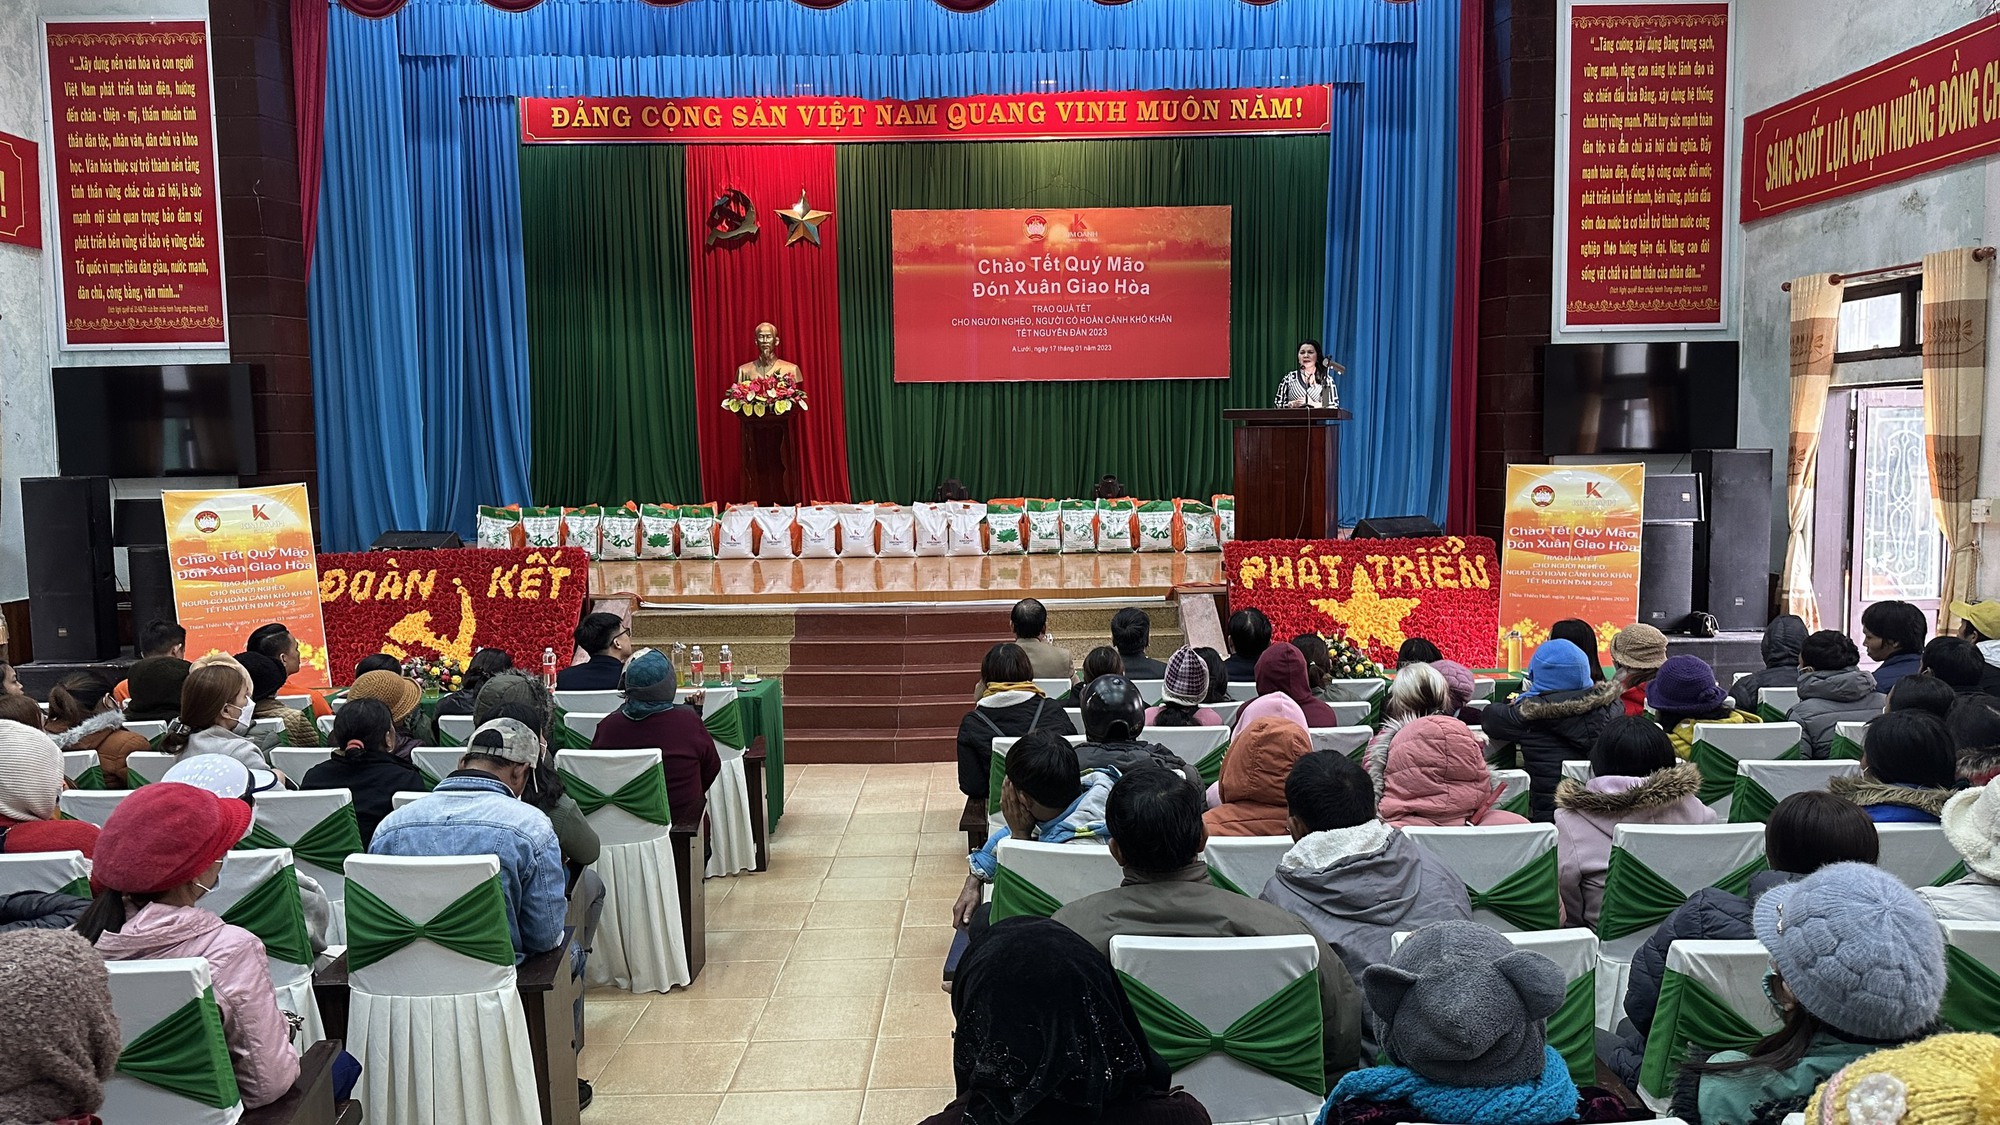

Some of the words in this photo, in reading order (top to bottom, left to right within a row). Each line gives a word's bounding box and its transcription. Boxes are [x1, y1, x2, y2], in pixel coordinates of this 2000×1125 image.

[1616, 36, 1633, 53] cường
[1635, 37, 1646, 53] xây
[1647, 36, 1662, 53] dựng
[1663, 33, 1679, 53] Đảng
[1681, 37, 1697, 52] trong
[1699, 35, 1715, 53] sạch,
[94, 56, 109, 73] dựng
[111, 54, 123, 70] nền
[125, 58, 137, 70] văn
[138, 56, 150, 70] hóa
[152, 57, 161, 70] và
[162, 59, 174, 70] con
[175, 55, 194, 72] người
[1584, 63, 1598, 80] vững
[1600, 62, 1619, 81] mạnh,
[1621, 63, 1635, 79] nâng
[1637, 65, 1648, 77] cao
[1651, 63, 1666, 78] năng
[1667, 61, 1677, 79] lực
[1678, 61, 1691, 76] lãnh
[1694, 61, 1705, 79] đạo
[1706, 63, 1714, 75] và
[64, 82, 78, 100] Việt
[82, 82, 96, 96] Nam
[100, 81, 115, 98] phát
[118, 78, 134, 96] triển
[137, 82, 152, 96] toàn
[175, 80, 195, 98] hướng
[551, 99, 632, 129] ĐẢNG
[641, 101, 722, 133] CỘNG
[732, 99, 788, 129] SẢN
[796, 100, 867, 131] VIỆT
[875, 103, 938, 126] NAM
[947, 101, 1047, 130] QUANG
[1055, 101, 1127, 123] VINH
[1136, 95, 1220, 122] MUÔN
[1230, 93, 1303, 120] NĂM!
[1765, 128, 1794, 192] SÁNG
[1794, 106, 1824, 183] SUỐT
[1826, 108, 1849, 181] LỰA
[1852, 102, 1887, 171] CHỌN
[1888, 76, 1935, 153] NHỮNG
[1938, 49, 1979, 138] ĐỒNG
[1581, 240, 1601, 259] nghiệp
[1603, 240, 1617, 256] theo
[1619, 240, 1637, 257] hướng
[1640, 239, 1653, 257] hiện
[1655, 239, 1667, 257] đại.
[1669, 239, 1685, 256] Nâng
[1687, 243, 1698, 254] cao
[1700, 239, 1710, 254] đời
[75, 257, 84, 275] Tổ
[86, 258, 102, 277] quốc
[102, 260, 108, 273] vì
[110, 263, 124, 277] mục
[124, 260, 138, 273] tiêu
[139, 259, 151, 274] dân
[152, 259, 170, 276] giàu,
[171, 259, 187, 274] nước
[188, 259, 209, 276] mạnh,
[978, 258, 1026, 275] Chào
[1031, 253, 1060, 272] Tết
[1065, 256, 1102, 275] Quý
[1107, 256, 1145, 272] Mão
[972, 282, 1009, 298] Đón
[1015, 279, 1061, 295] Xuân
[1067, 279, 1109, 294] Giao
[1115, 279, 1150, 295] Hòa
[1032, 305, 1054, 313] TRAO
[951, 317, 970, 326] CHO
[971, 316, 1000, 326] NGƯỜI
[1001, 316, 1034, 326] NGHÈO,
[1035, 315, 1064, 325] NGƯỜI
[1080, 315, 1103, 325] HOÀN
[1105, 314, 1128, 324] CẢNH
[1130, 314, 1147, 324] KHÓ
[1149, 313, 1172, 323] KHĂN
[1033, 327, 1068, 337] NGUYÊN
[1089, 328, 1108, 336] 2023
[1509, 526, 1545, 537] Chào
[1549, 525, 1571, 535] Tết
[1574, 525, 1602, 538] Quý
[1507, 538, 1534, 549] Đón
[1537, 538, 1570, 549] Xuân
[1574, 539, 1605, 550] Giao
[1609, 540, 1637, 552] Hòa
[1240, 544, 1342, 589] PHÁT
[1366, 536, 1490, 590] TRIỂN
[319, 558, 437, 603] ĐOÀN
[487, 550, 571, 599] KẾT
